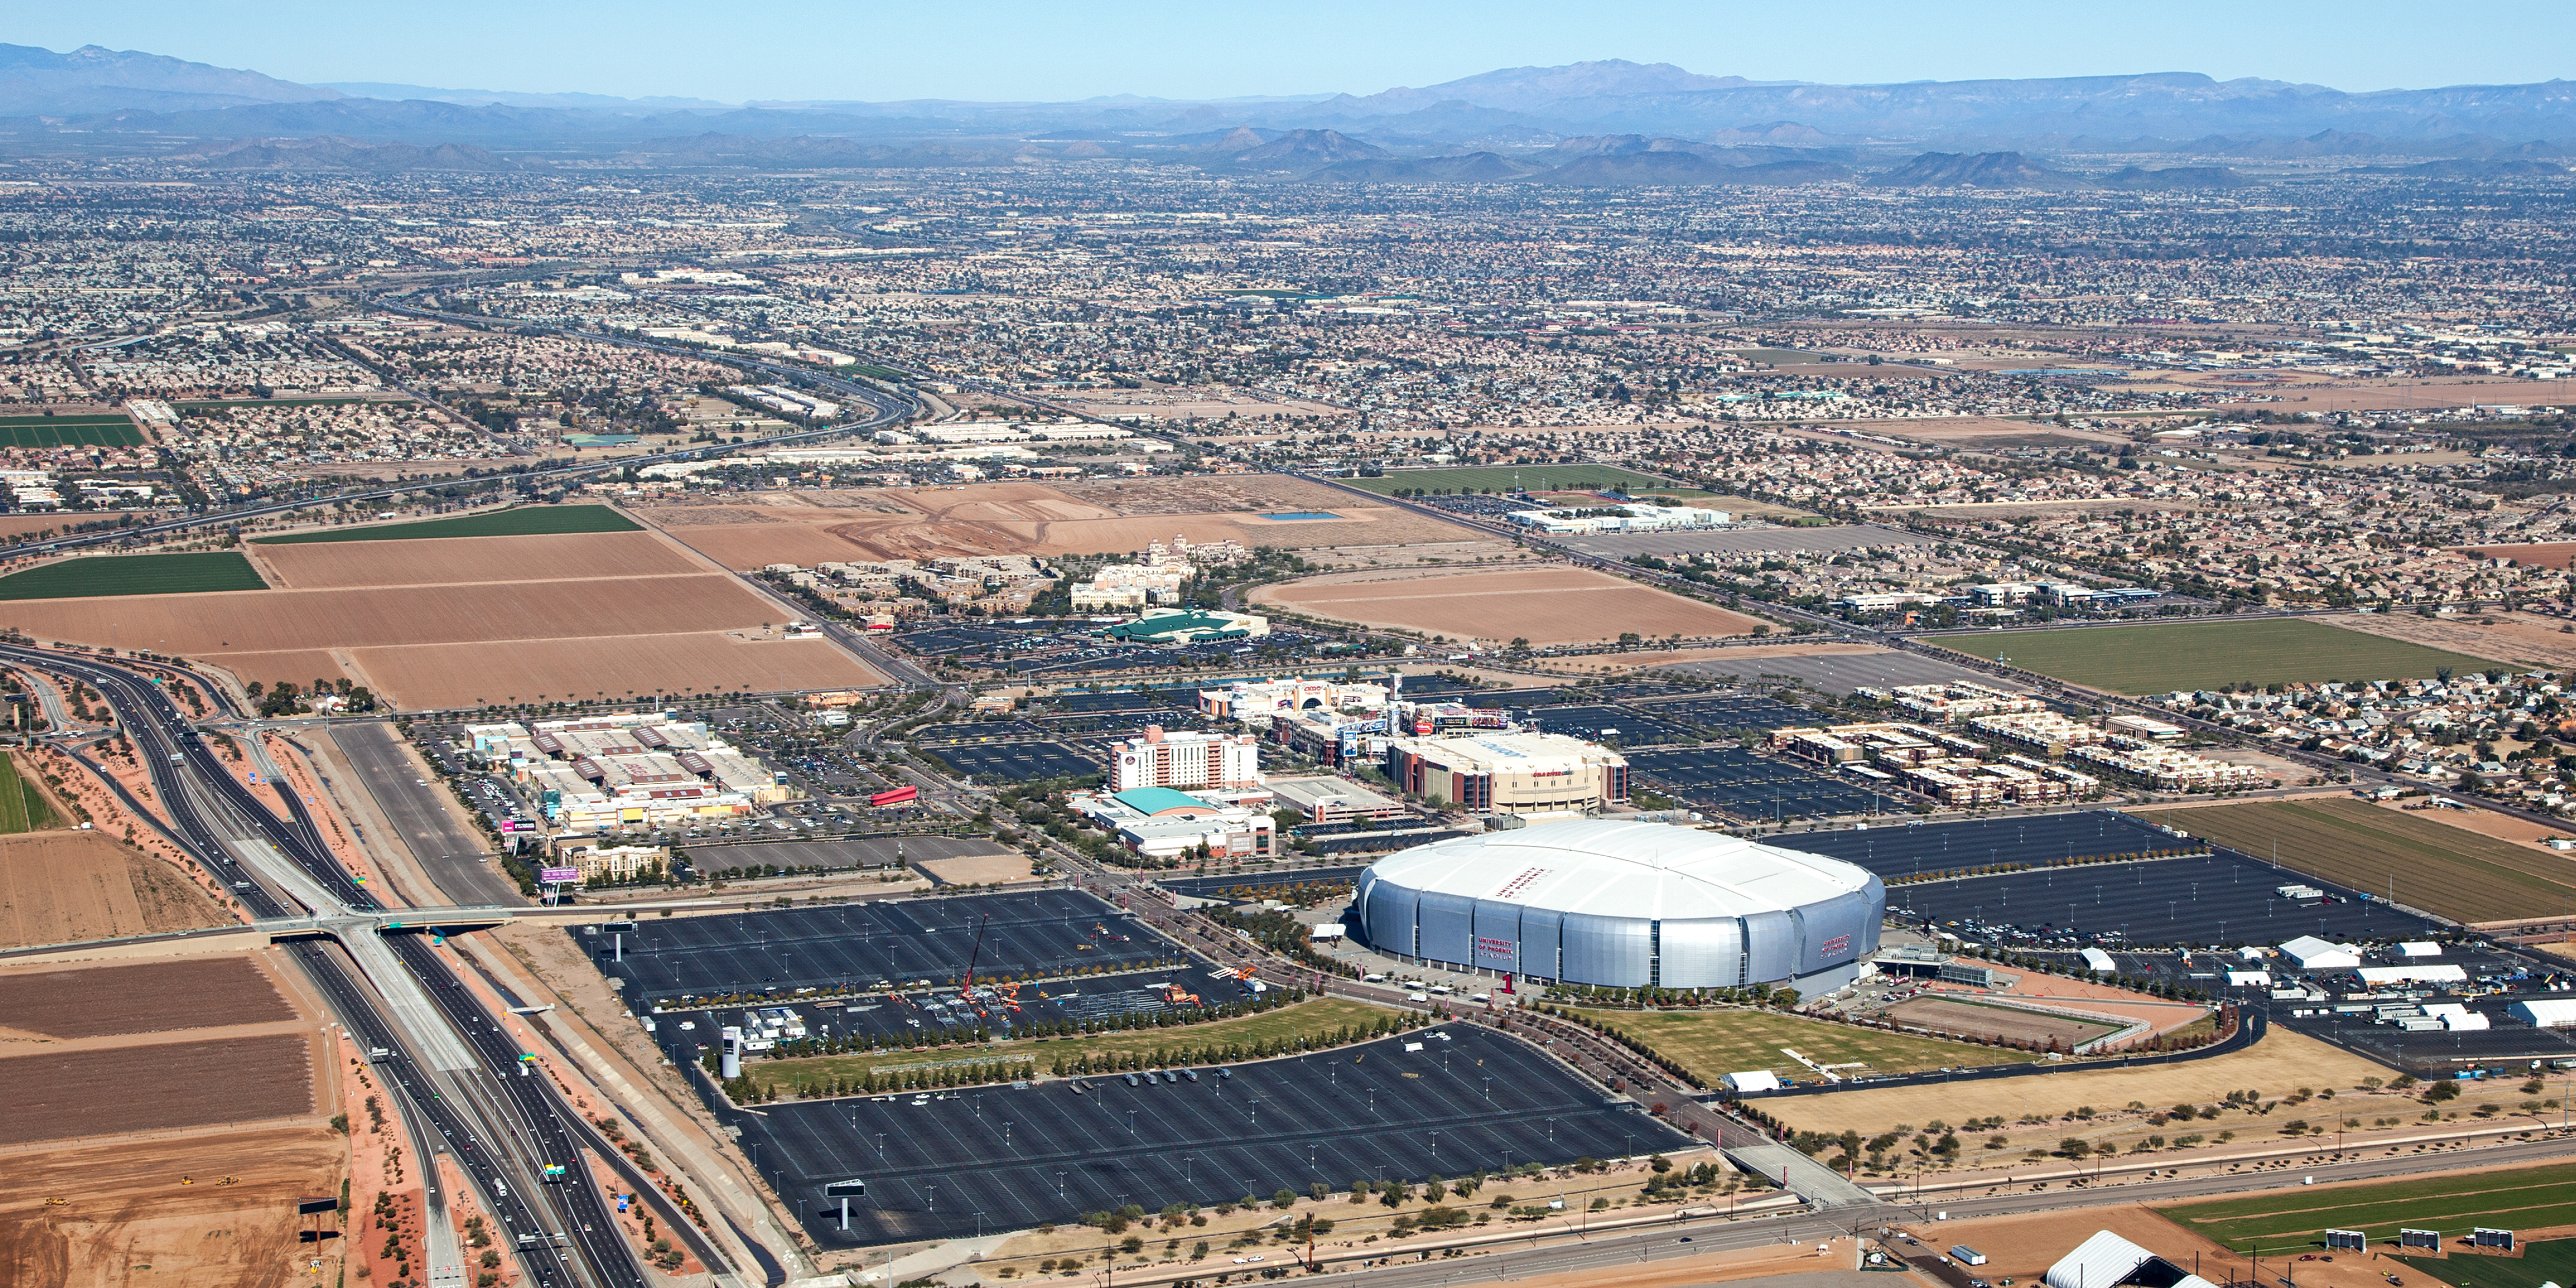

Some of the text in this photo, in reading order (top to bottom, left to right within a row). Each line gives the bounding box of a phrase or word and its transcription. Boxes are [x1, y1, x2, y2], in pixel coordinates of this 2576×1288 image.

[1496, 867, 1536, 896] UNIVERSITY
[1513, 869, 1555, 899] STADIUM
[1515, 869, 1546, 889] PHOENIX
[1479, 938, 1512, 947] UNIVERSITY
[1479, 952, 1513, 961] STADIUM
[1502, 974, 1515, 994] 1
